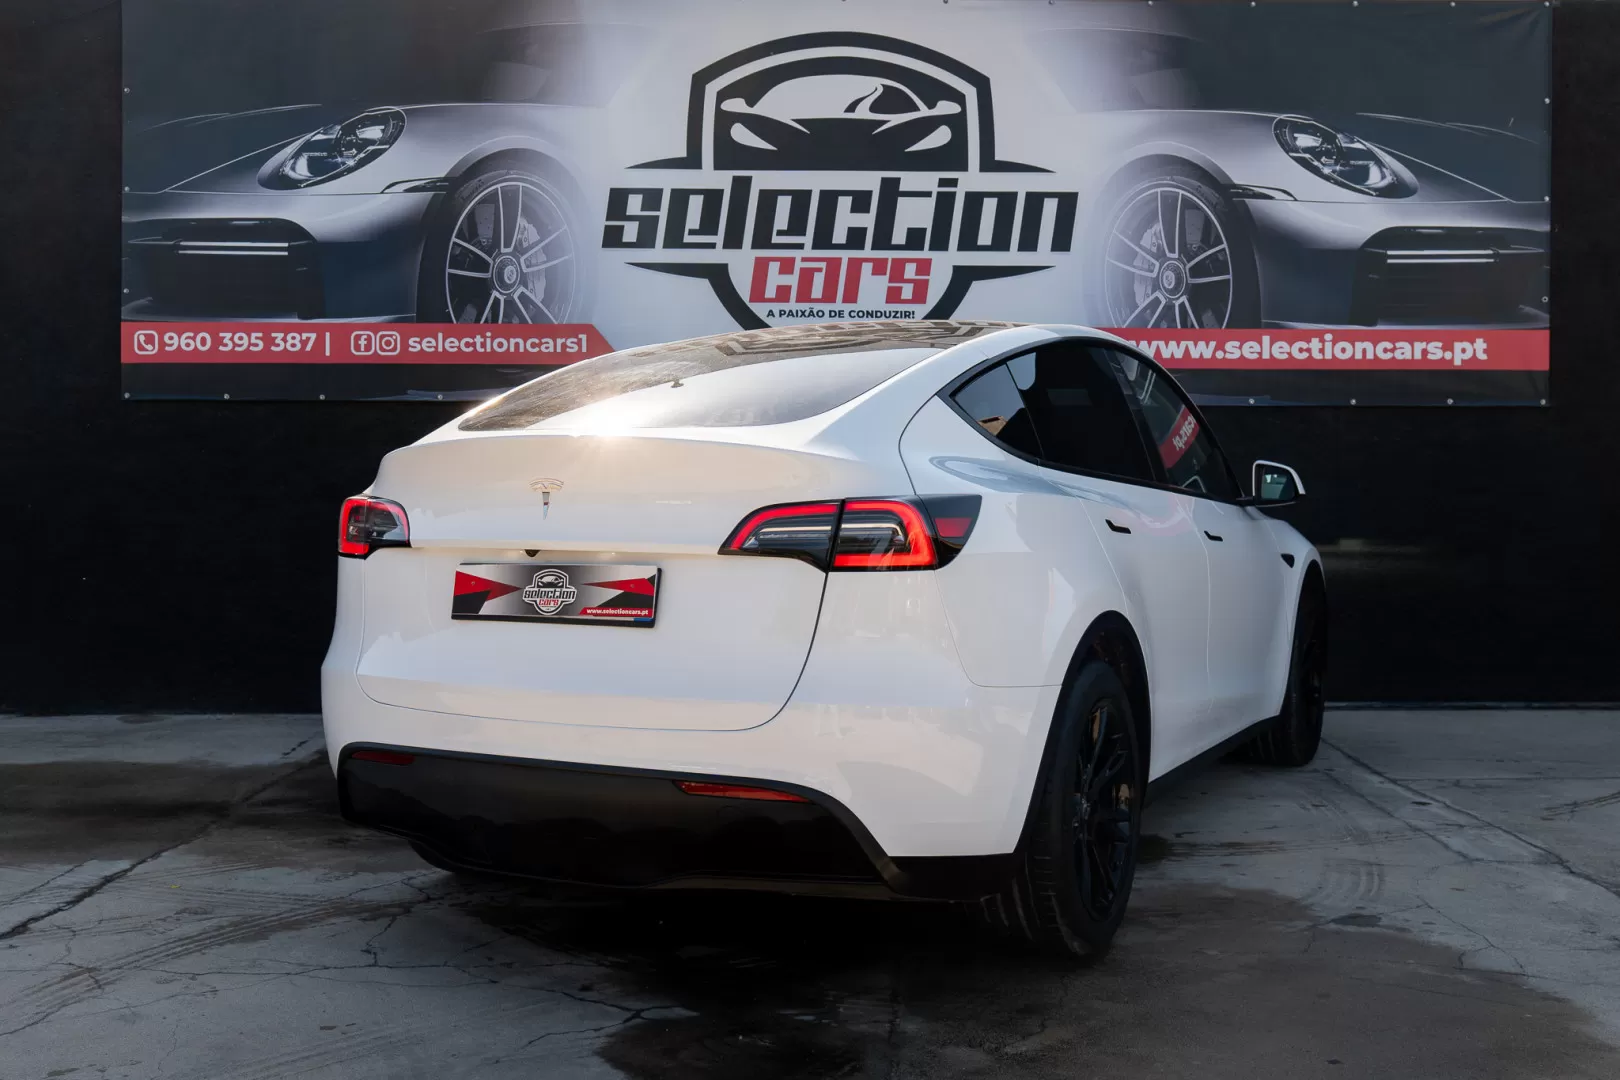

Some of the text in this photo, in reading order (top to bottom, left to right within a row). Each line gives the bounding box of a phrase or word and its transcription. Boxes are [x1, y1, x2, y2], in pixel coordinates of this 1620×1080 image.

[601, 175, 1079, 252] selection
[748, 256, 933, 304] cars
[766, 307, 915, 319] A PAIXÃO DE CONDUZIR!
[163, 332, 212, 352] 960
[218, 332, 264, 352] 395
[270, 332, 317, 352] 387
[408, 332, 588, 353] selectioncars1
[586, 608, 649, 616] www.selectioncars.pt
